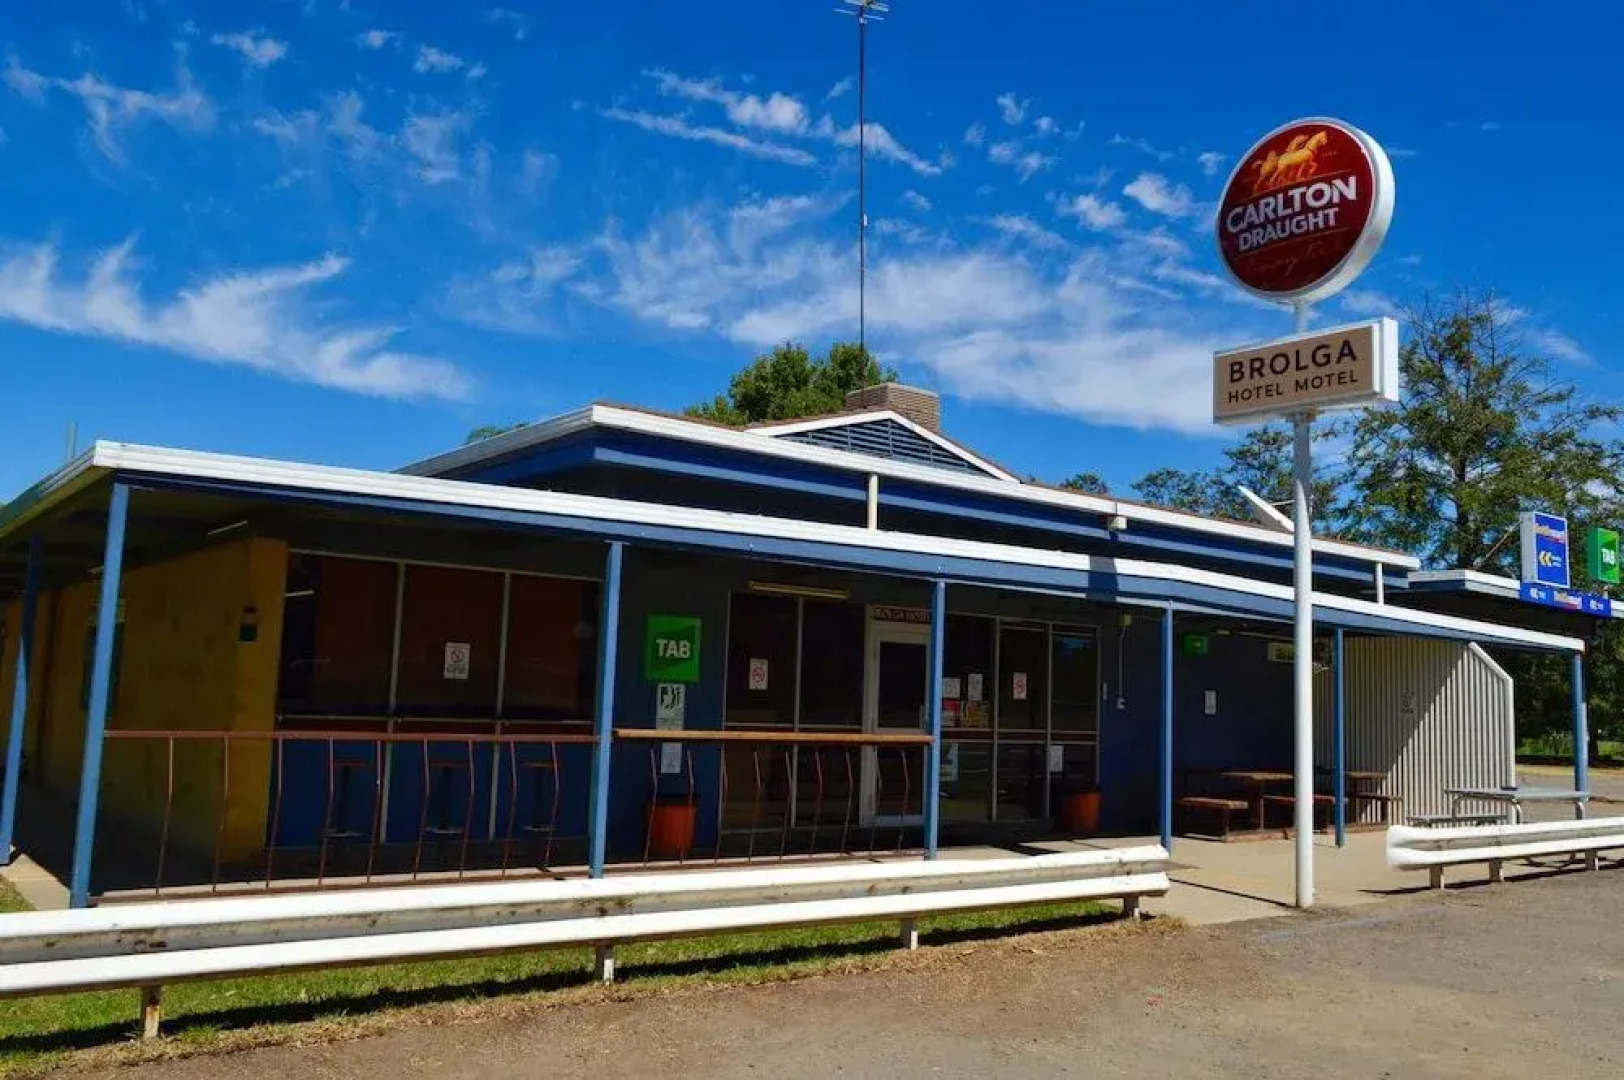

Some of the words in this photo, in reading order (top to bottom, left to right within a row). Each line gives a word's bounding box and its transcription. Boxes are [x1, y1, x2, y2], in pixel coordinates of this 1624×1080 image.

[1226, 176, 1357, 234] CARLTON
[1238, 207, 1339, 251] DRAUGHT
[1229, 339, 1358, 383] BROLGA
[1228, 384, 1283, 404] HOTEL
[1295, 370, 1359, 393] MOTEL
[655, 638, 691, 659] TAB
